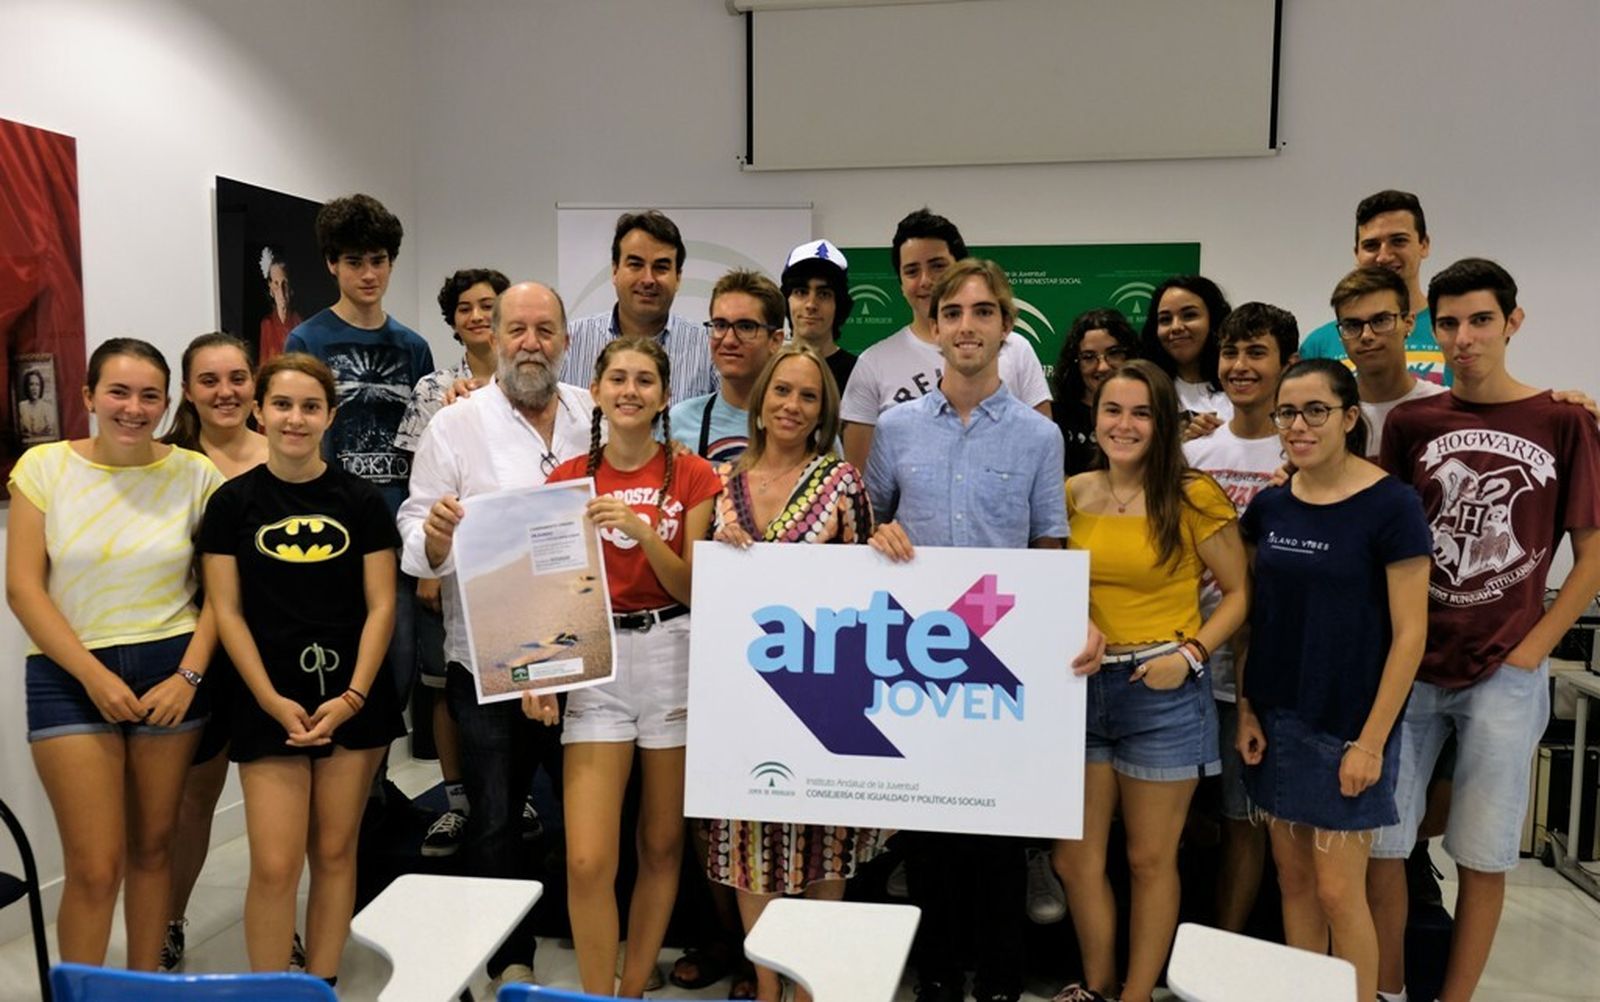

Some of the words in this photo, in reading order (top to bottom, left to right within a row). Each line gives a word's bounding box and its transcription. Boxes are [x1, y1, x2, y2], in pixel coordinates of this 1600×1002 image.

[1436, 432, 1550, 467] HOGWARTS
[341, 456, 408, 476] TOKYO
[603, 487, 683, 517] POSTALE
[1460, 505, 1485, 534] H
[864, 679, 1024, 721] JOVEN
[806, 789, 853, 799] CONSEJERÍA
[855, 791, 865, 800] DE
[867, 791, 909, 802] IGUALDAD
[958, 797, 996, 807] SOCIALES
[837, 780, 865, 788] Andaluz
[866, 781, 876, 789] de
[878, 781, 885, 789] la
[887, 782, 919, 790] Juventud
